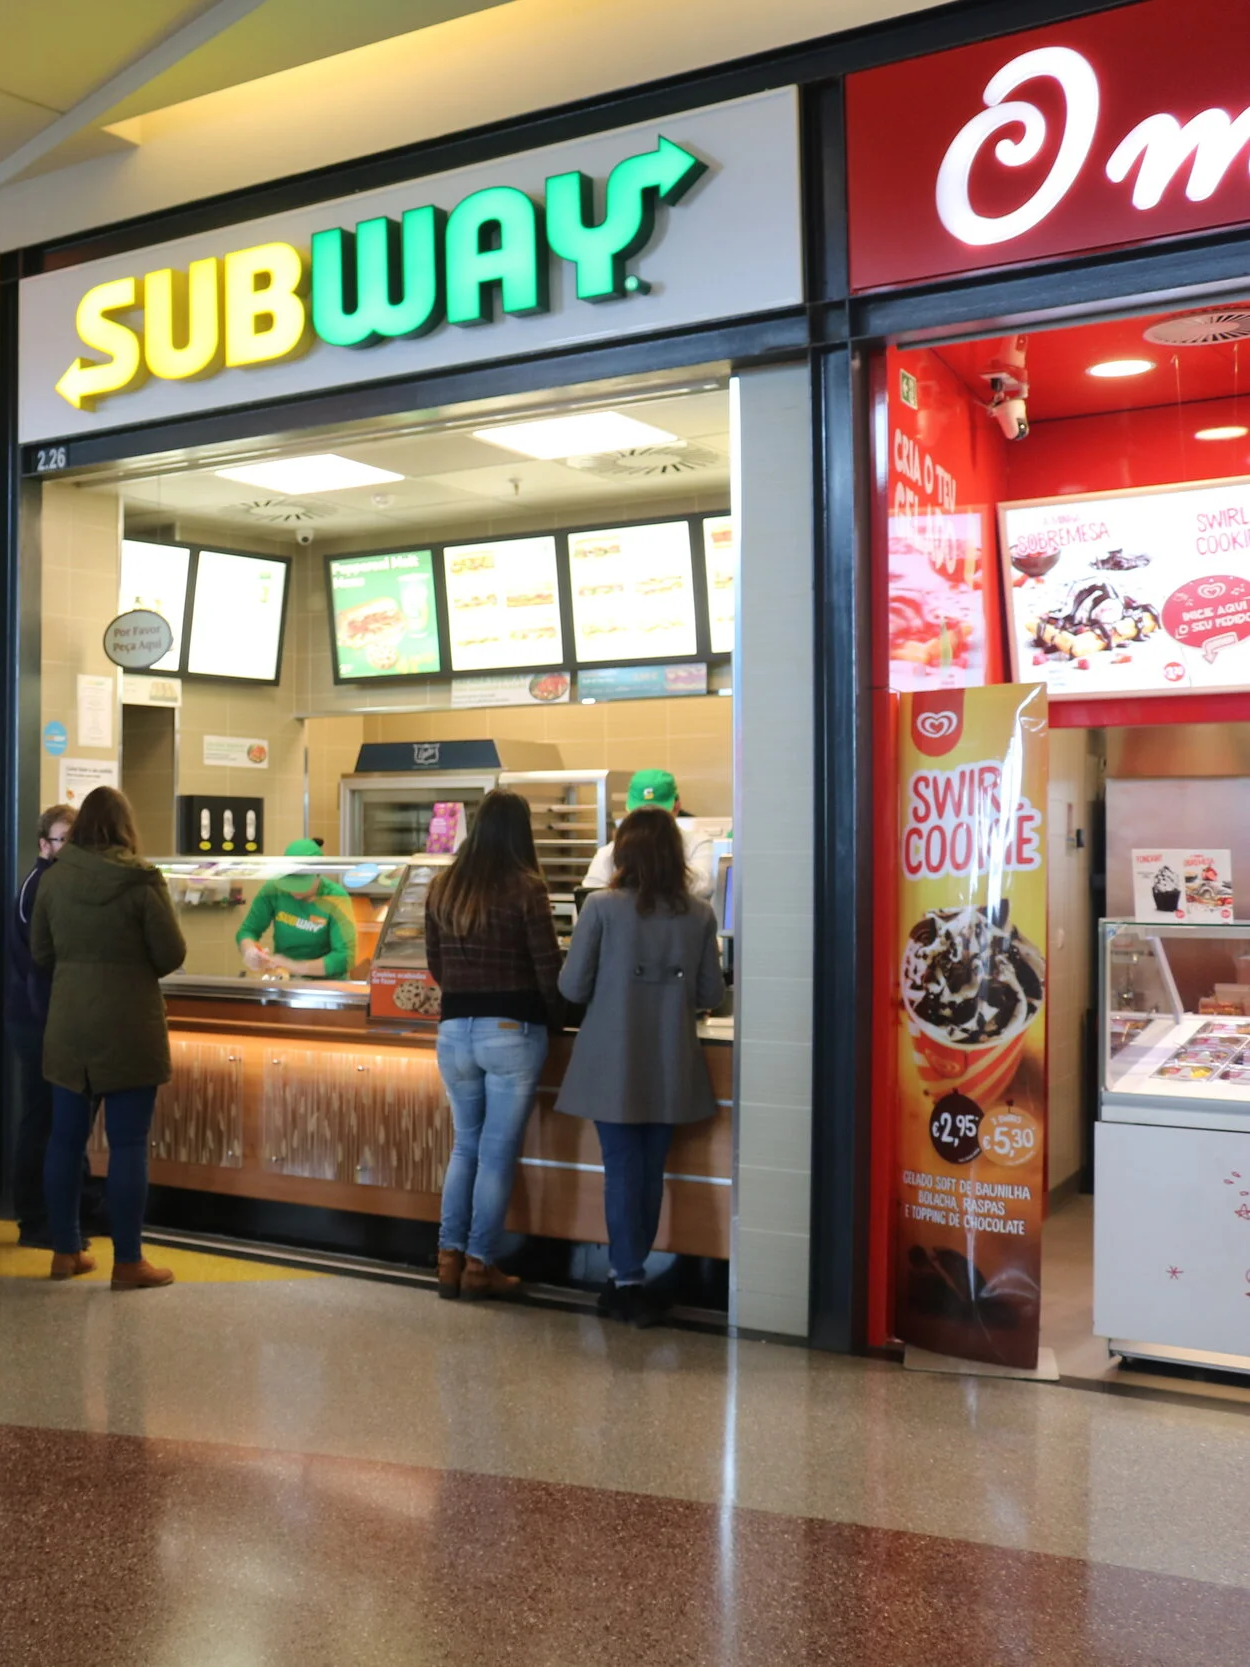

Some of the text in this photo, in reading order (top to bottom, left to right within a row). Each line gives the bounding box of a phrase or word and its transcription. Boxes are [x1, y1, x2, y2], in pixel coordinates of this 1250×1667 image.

[55, 134, 708, 410] SUBWAY
[37, 449, 66, 472] 2.26
[894, 428, 957, 513] CRIA O TEU
[1196, 507, 1250, 533] SWIRL
[1017, 522, 1111, 553] SOBREMESA
[1217, 601, 1248, 615] AQUI
[113, 625, 161, 639] Por Favor
[1191, 620, 1212, 632] SEU
[112, 639, 162, 654] Peça Aqui
[902, 1170, 1030, 1200] GELADO SOFT DE BAUNILHA
[963, 1197, 1006, 1216] RASPAS
[904, 1204, 1026, 1235] E TOPPING DE CHOCOLATE
